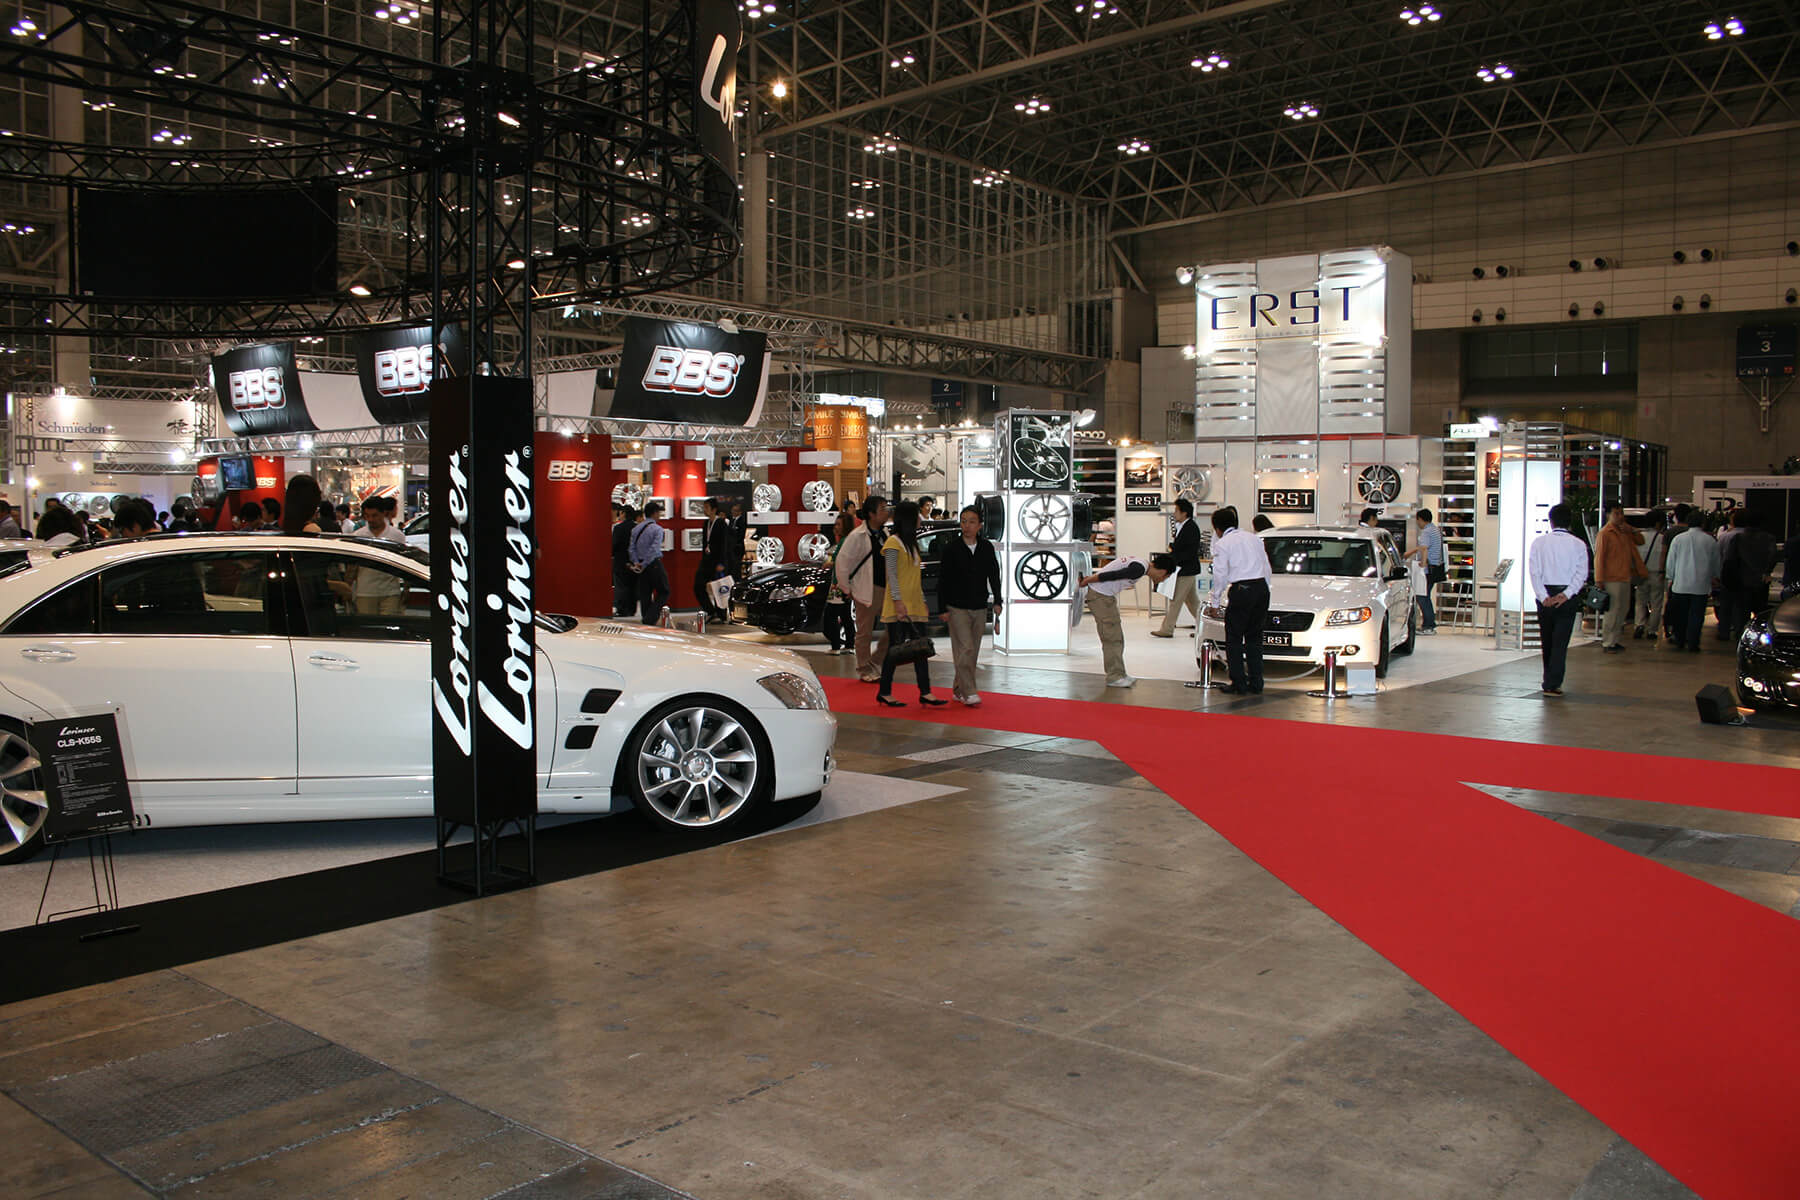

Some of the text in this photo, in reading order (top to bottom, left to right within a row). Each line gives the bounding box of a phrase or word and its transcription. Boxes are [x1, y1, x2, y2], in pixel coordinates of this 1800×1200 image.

[1211, 286, 1361, 330] ERST
[1760, 340, 1771, 352] 3
[643, 345, 740, 398] BBS
[230, 367, 286, 412] BBS
[943, 383, 950, 392] 2
[548, 460, 588, 480] BBS
[1127, 496, 1160, 506] ERST
[1260, 492, 1311, 506] ERST
[433, 450, 471, 757] Lorinser
[477, 450, 533, 750] Lorinser
[57, 735, 102, 748] CLS-K55S
